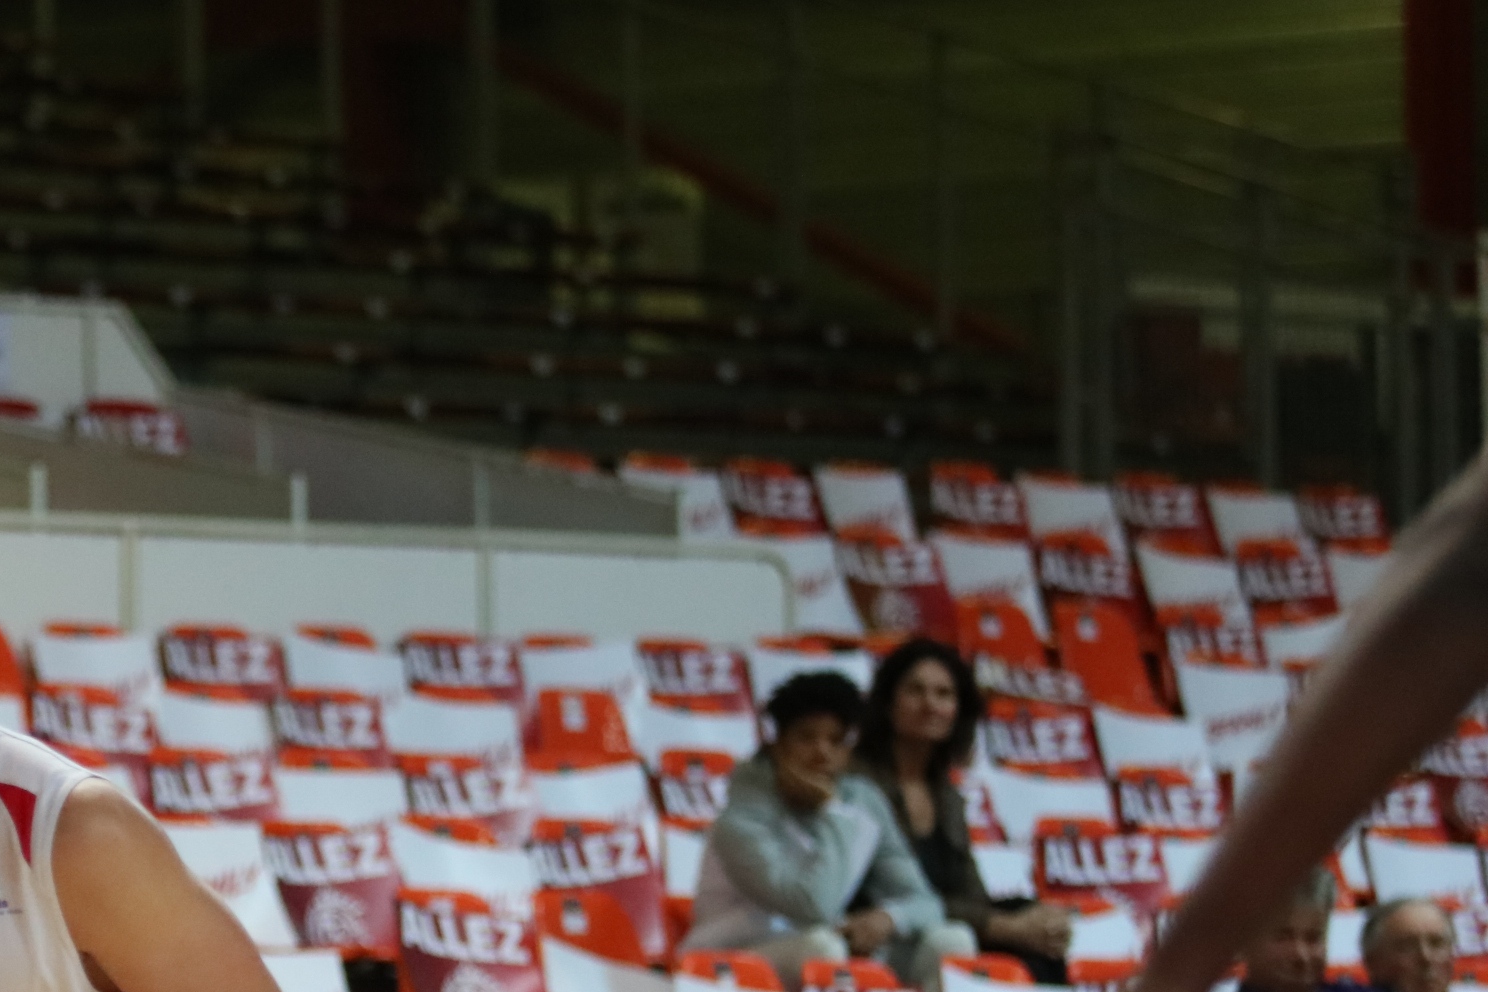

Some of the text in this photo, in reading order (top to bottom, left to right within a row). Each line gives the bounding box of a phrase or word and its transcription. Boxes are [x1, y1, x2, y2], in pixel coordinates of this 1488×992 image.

[264, 834, 393, 886] ALLEZ
[536, 832, 647, 886] ALLEZ
[403, 904, 532, 963] ALLEZ
